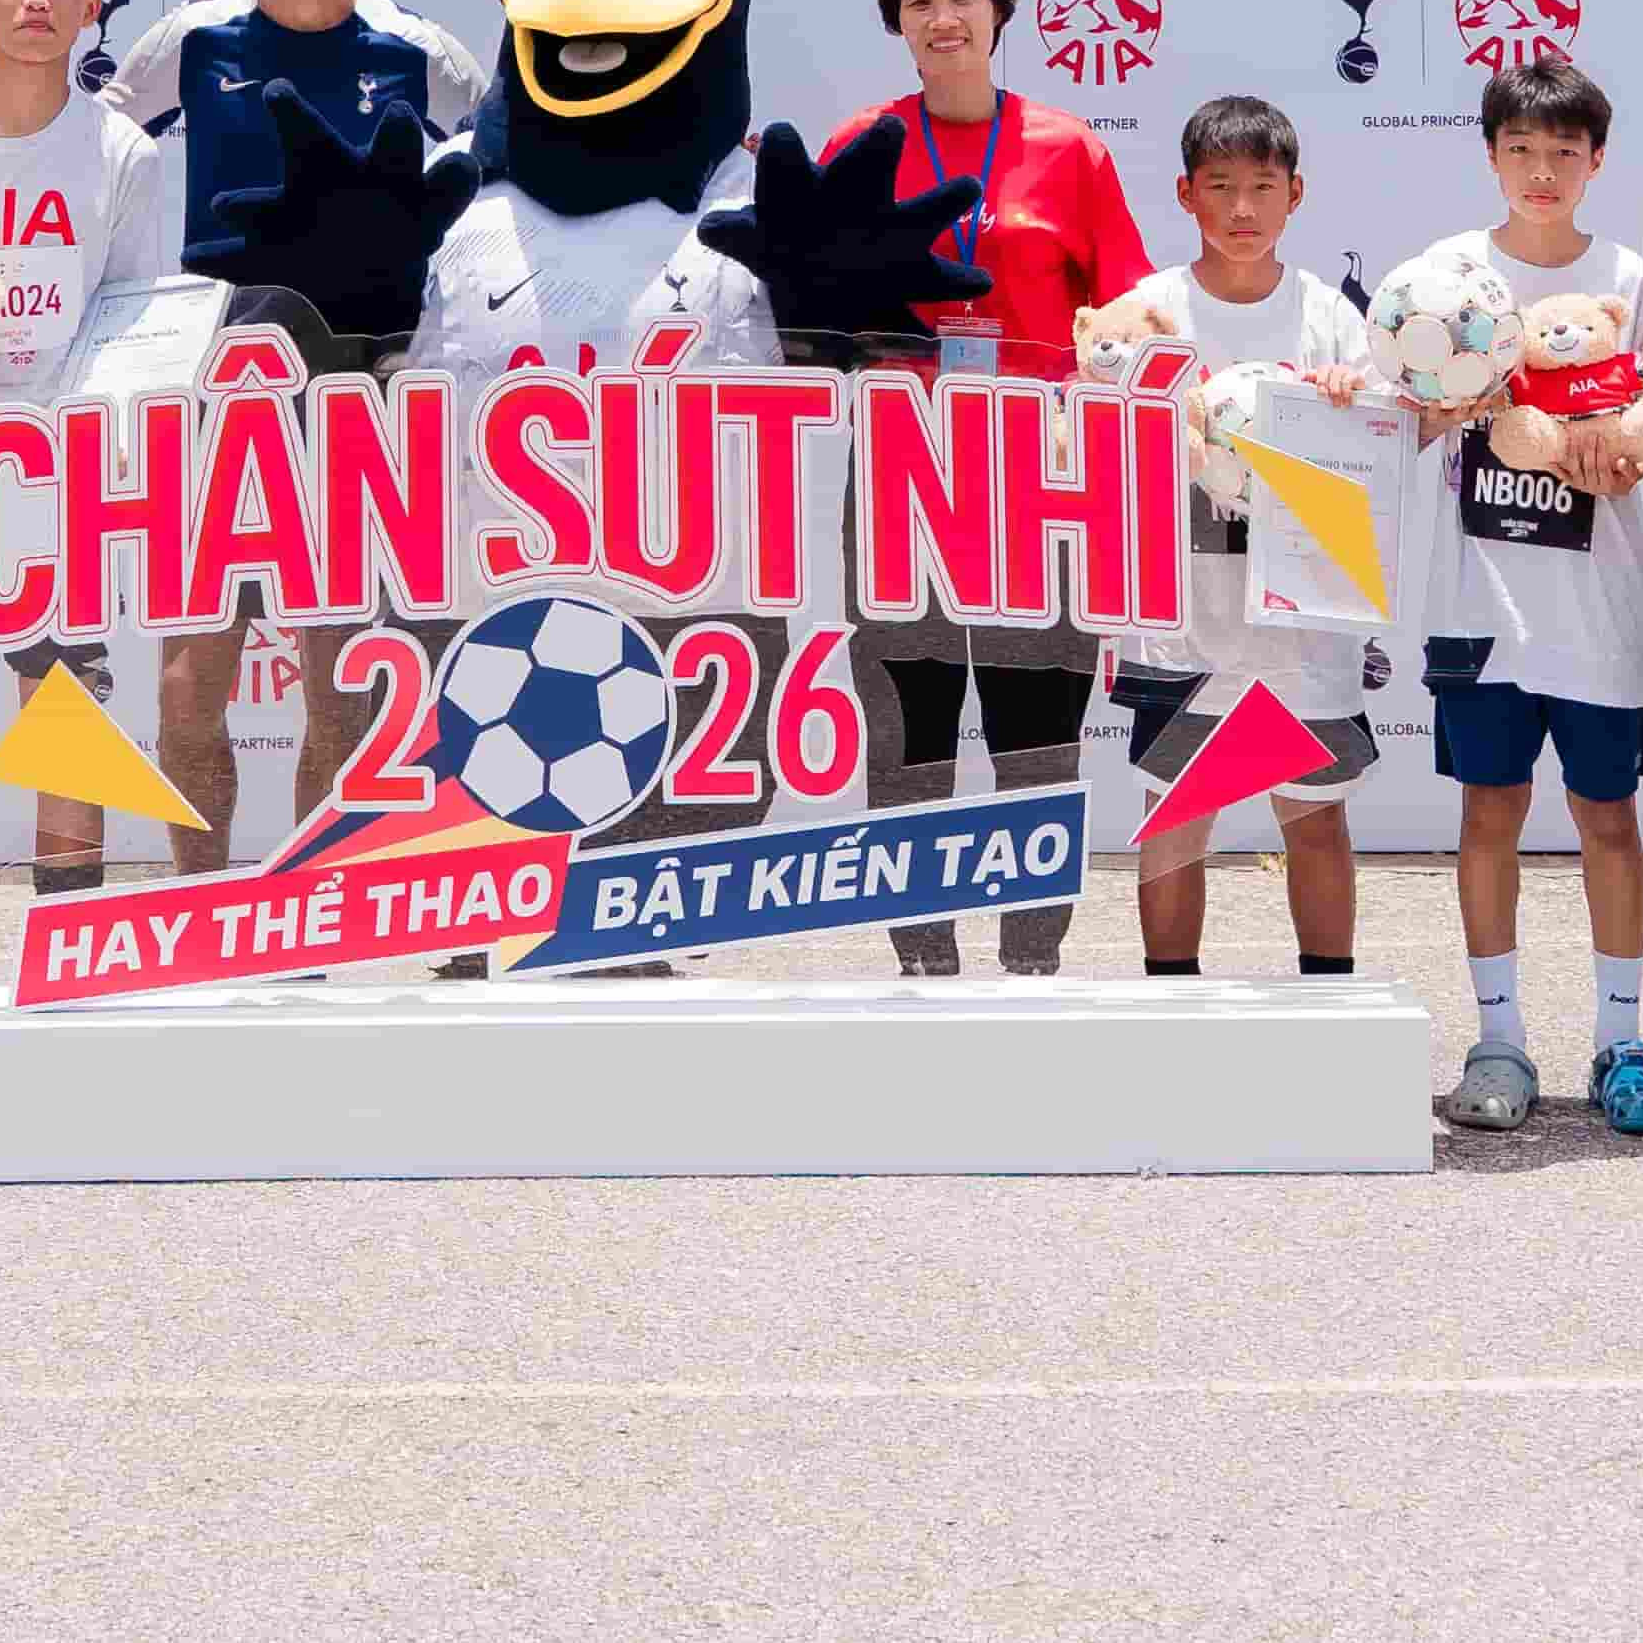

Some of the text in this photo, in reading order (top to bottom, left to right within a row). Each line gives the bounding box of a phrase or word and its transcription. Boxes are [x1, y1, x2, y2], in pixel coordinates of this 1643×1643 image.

[1045, 38, 1154, 85] AIA
[1084, 117, 1139, 131] ARTNER
[1361, 114, 1484, 128] GLOBAL PRINCIPA
[1568, 377, 1600, 395] AIA
[475, 318, 845, 606] SÚT
[861, 346, 1186, 632] NHÍ
[1474, 468, 1573, 513] NB006
[1375, 722, 1431, 735] GLOBAL
[230, 738, 294, 751] PARTNER
[592, 822, 1071, 937] BẬT KIẾN TẠO
[45, 862, 554, 983] HAY THỂ THAO
